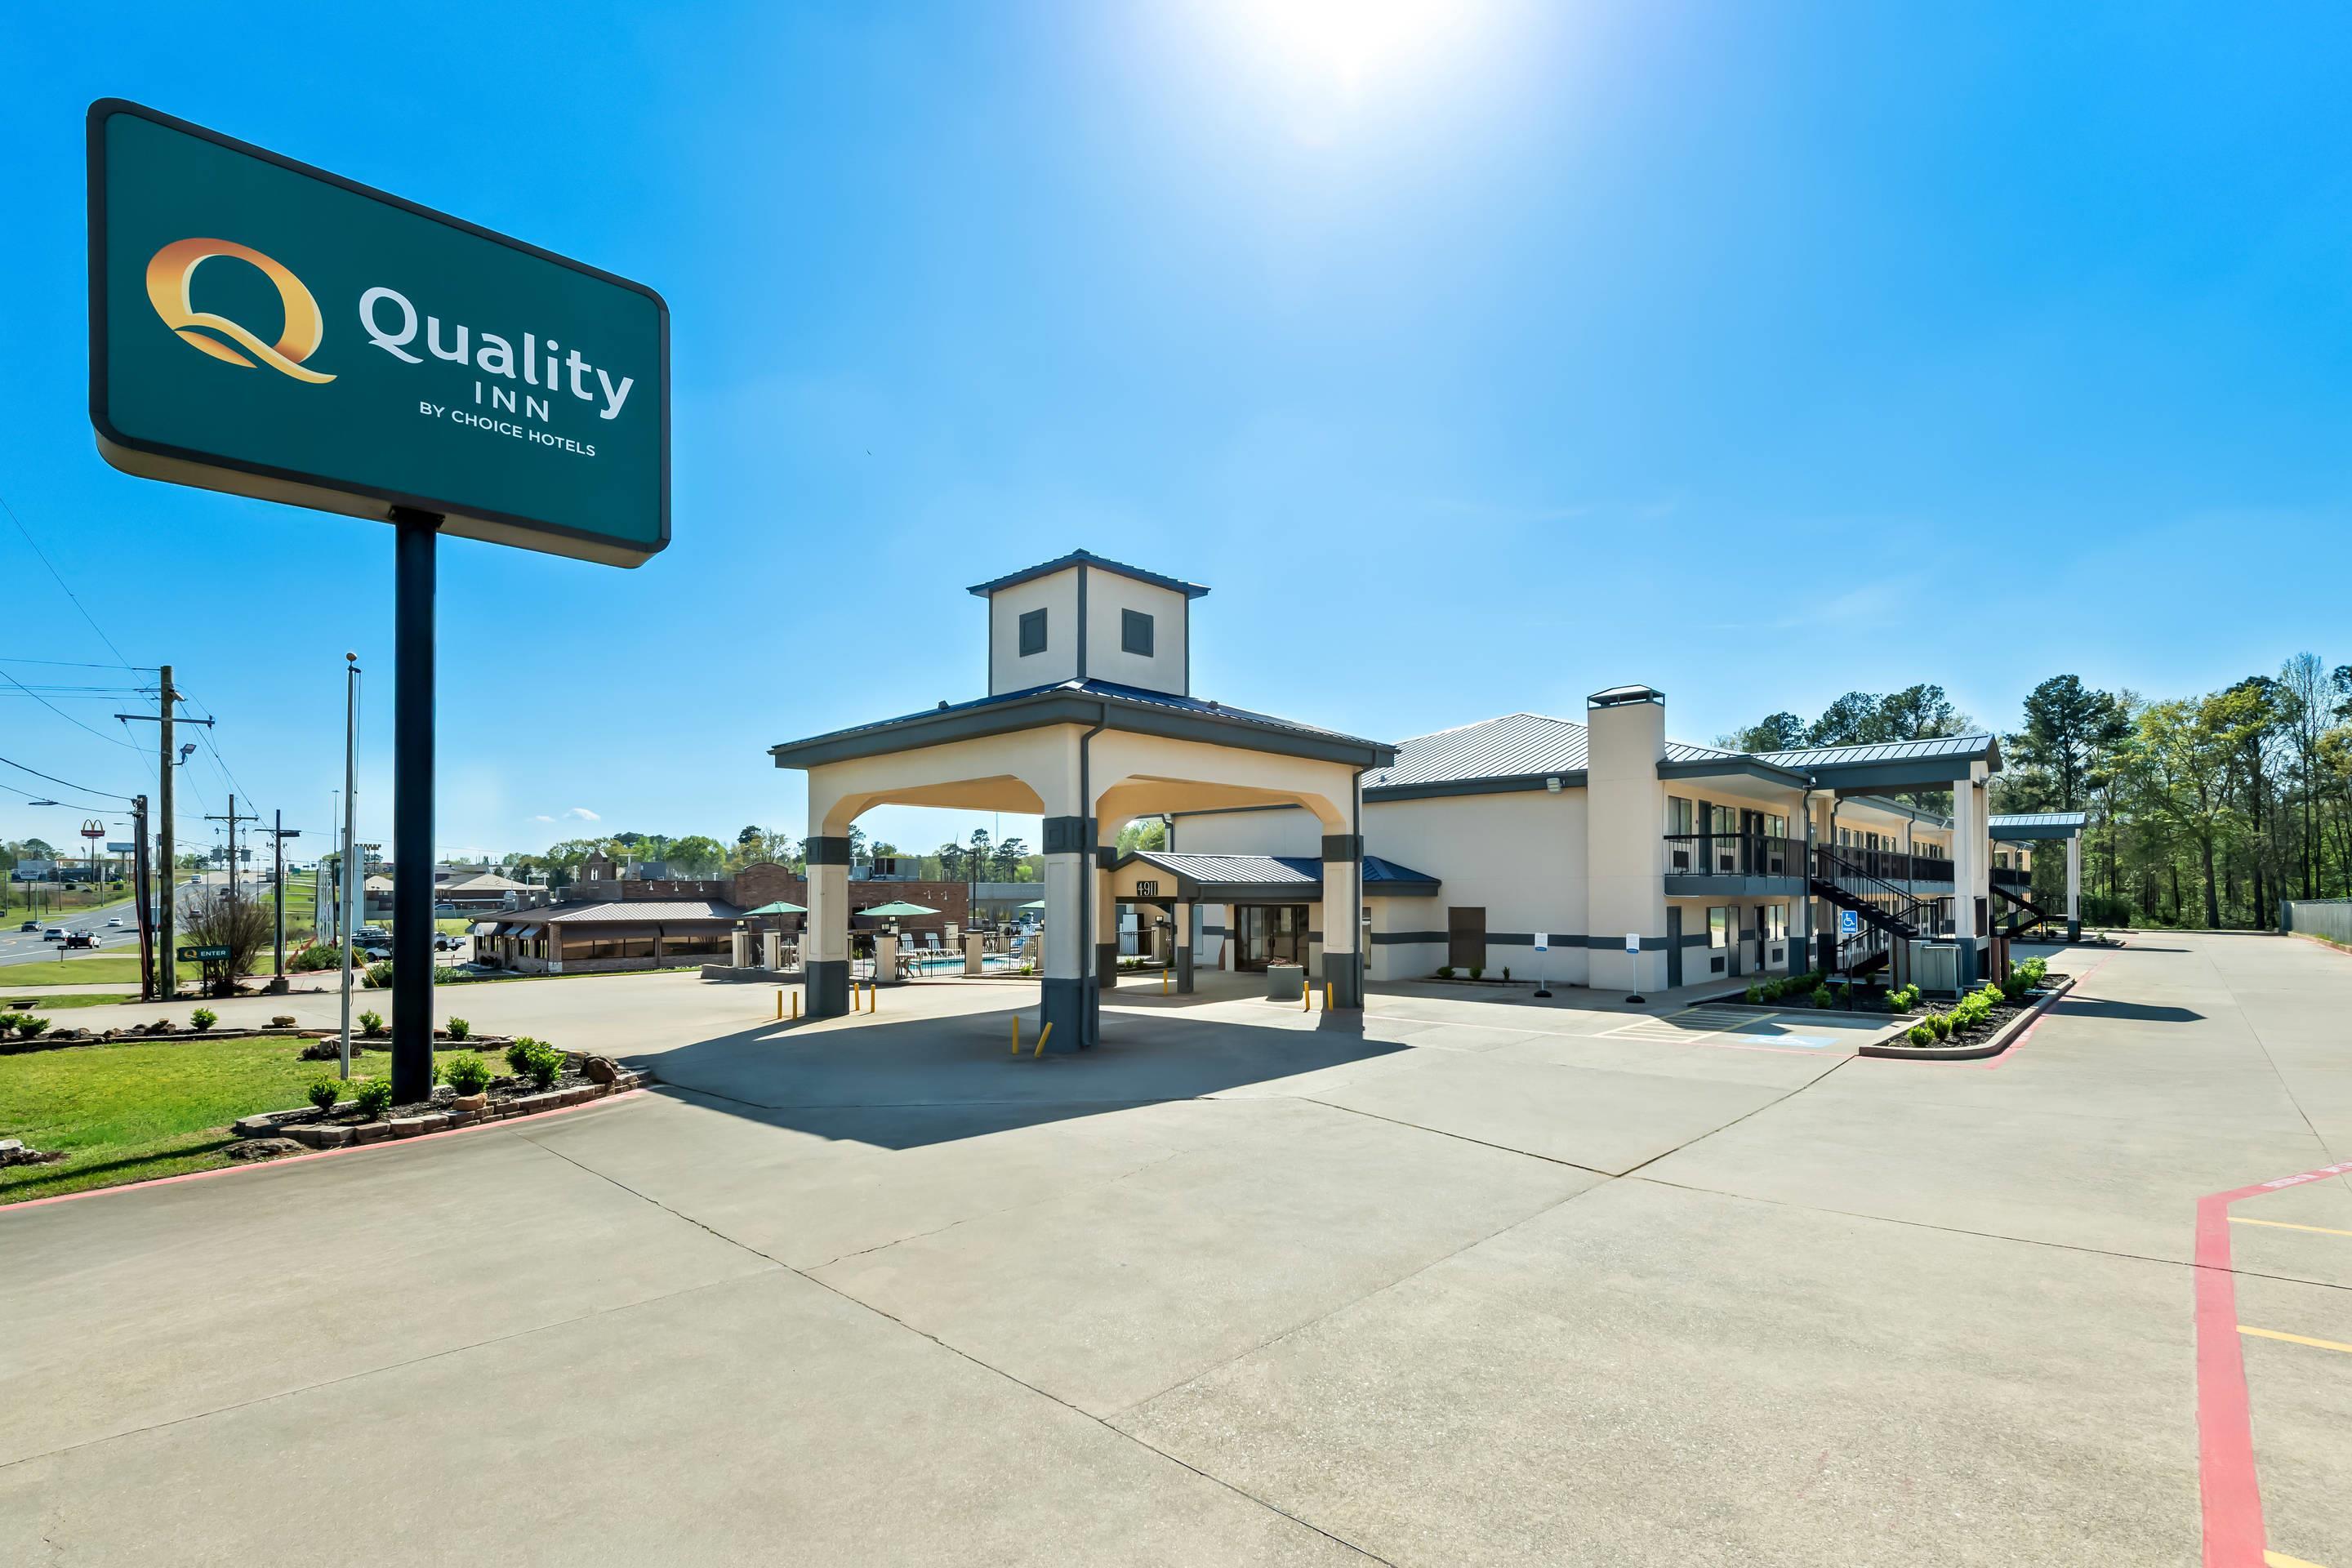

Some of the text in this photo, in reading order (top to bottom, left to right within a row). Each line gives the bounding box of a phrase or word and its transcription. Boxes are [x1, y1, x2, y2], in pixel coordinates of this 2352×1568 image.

[359, 287, 634, 420] Quality
[475, 381, 549, 422] INN
[420, 401, 595, 457] BY CHOICE HOTELS
[1138, 882, 1156, 896] 4911
